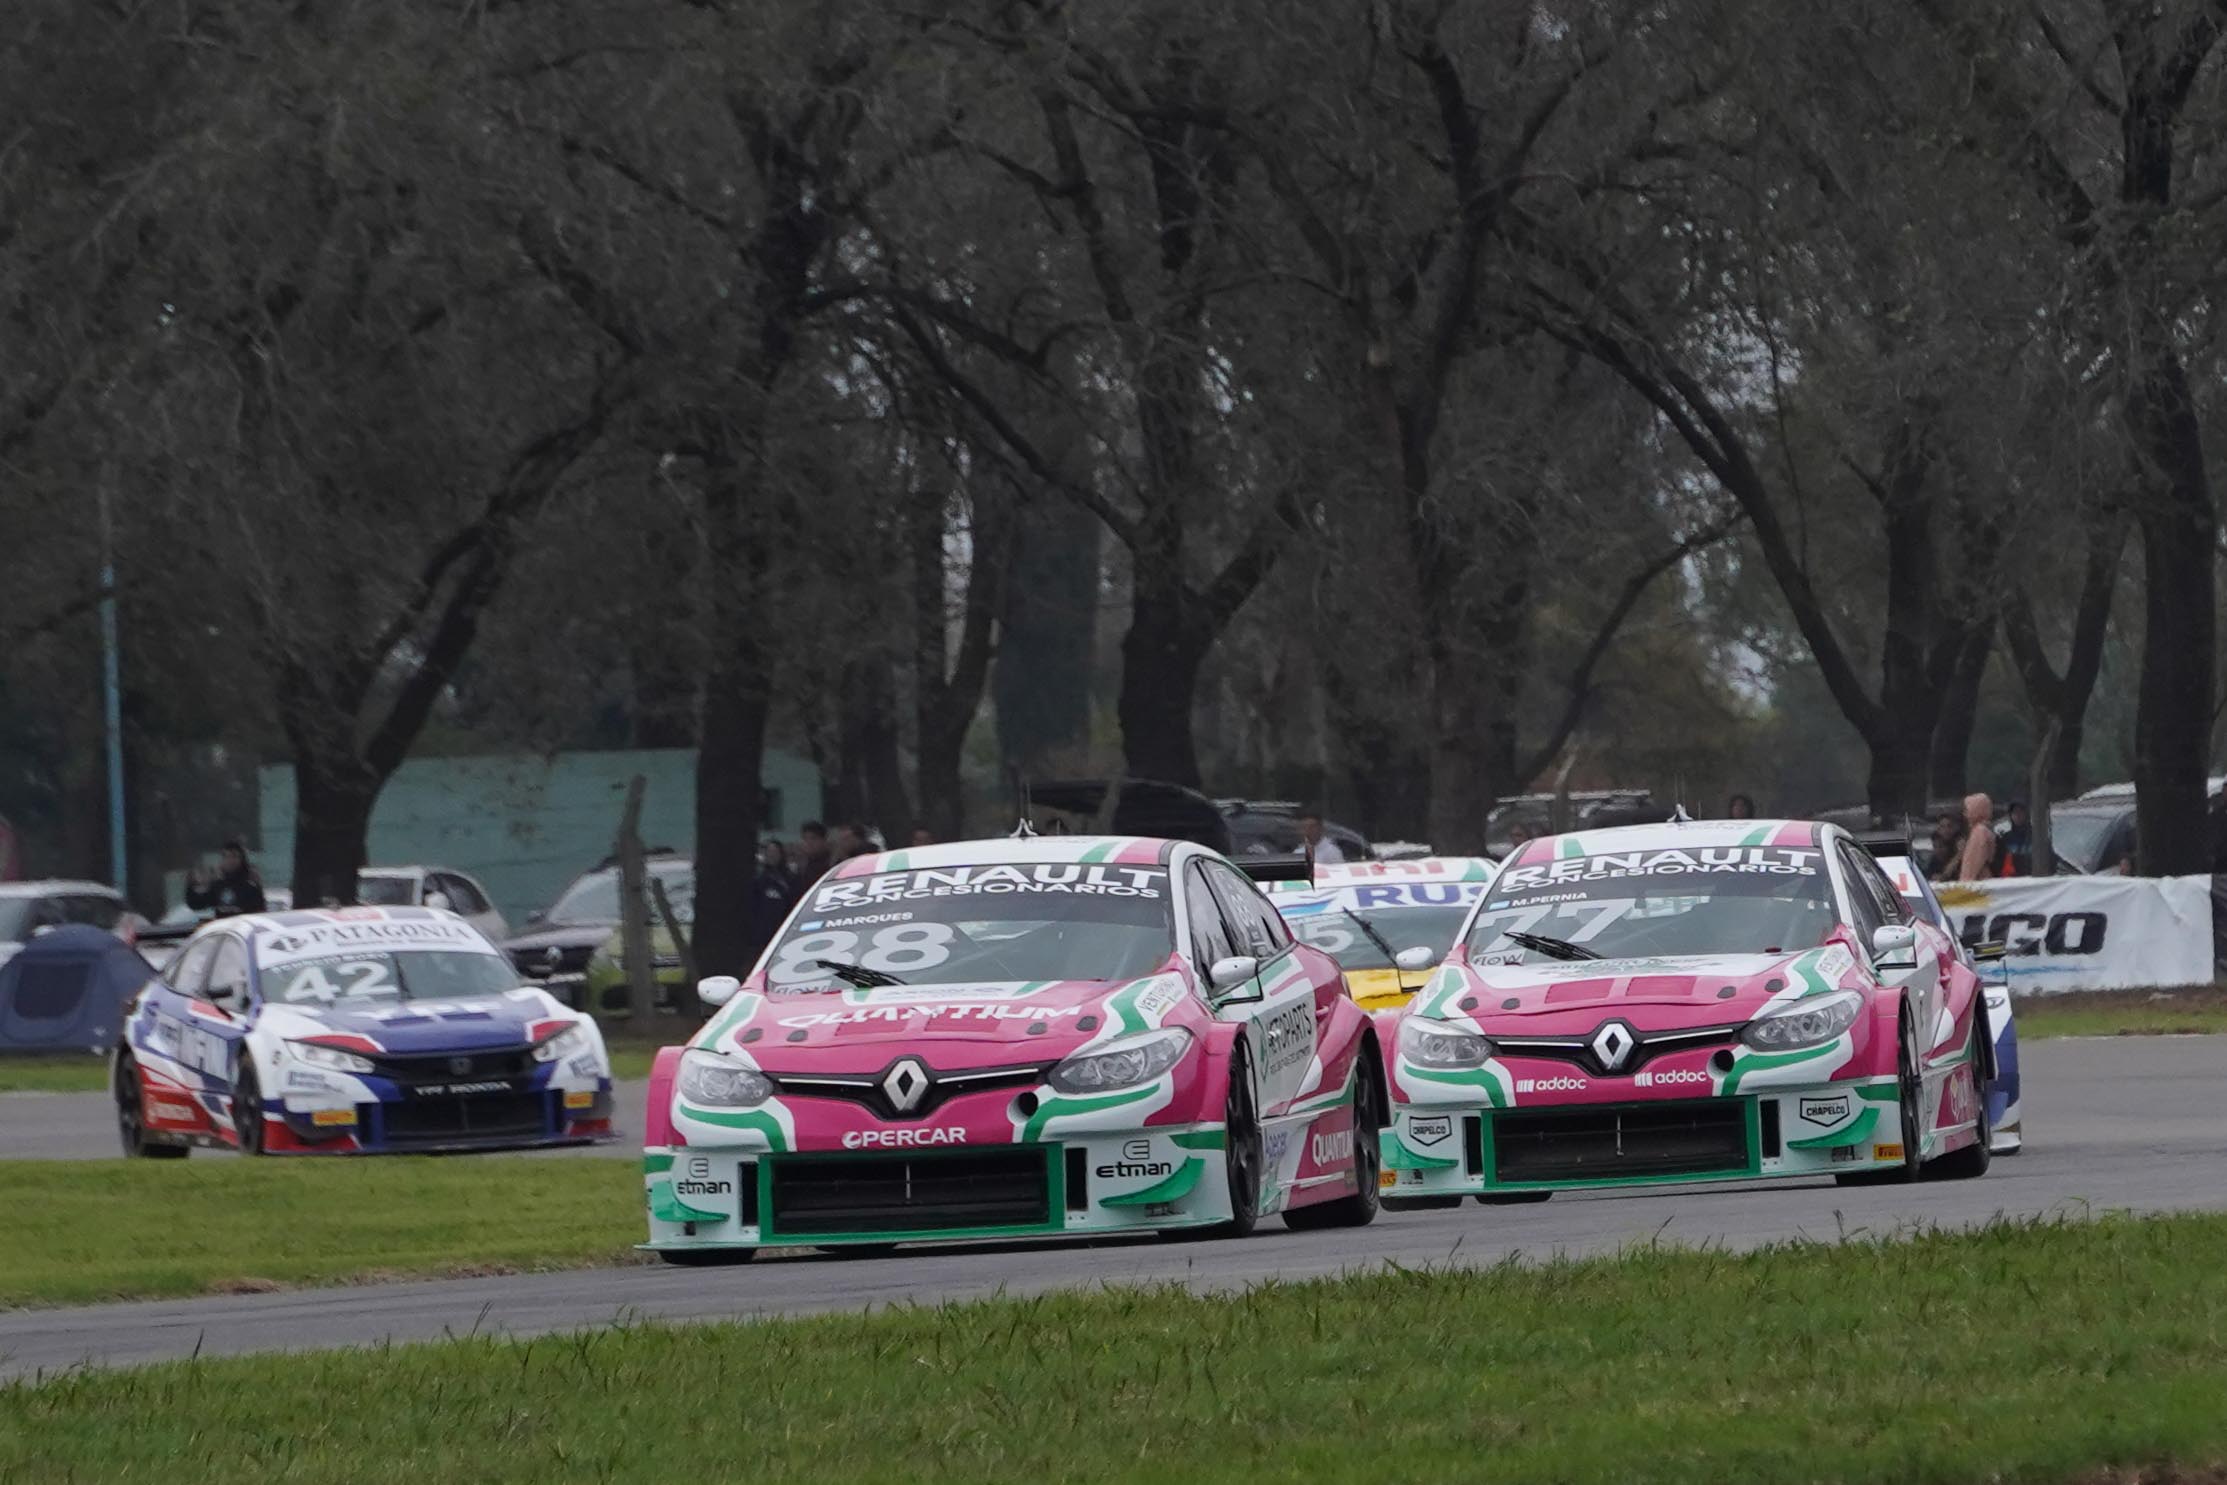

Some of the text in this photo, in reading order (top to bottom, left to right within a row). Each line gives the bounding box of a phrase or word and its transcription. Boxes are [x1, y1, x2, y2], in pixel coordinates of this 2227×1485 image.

[1502, 848, 1821, 888] RENAULT
[1502, 863, 1817, 893] CONCESIONARIOS
[814, 866, 1168, 905] RENAULT
[812, 883, 1161, 913] CONCESIONARIOS
[1512, 891, 1588, 906] M.PERNIA
[825, 912, 914, 929] MARQUES
[1475, 898, 1637, 956] 77
[768, 922, 954, 984] 88
[284, 960, 400, 1002] 42
[1535, 1077, 1588, 1091] addoc
[1654, 1069, 1707, 1084] addoc
[1806, 1103, 1847, 1118] CHAPELCO
[1096, 1161, 1172, 1178] etman
[677, 1179, 731, 1194] etman
